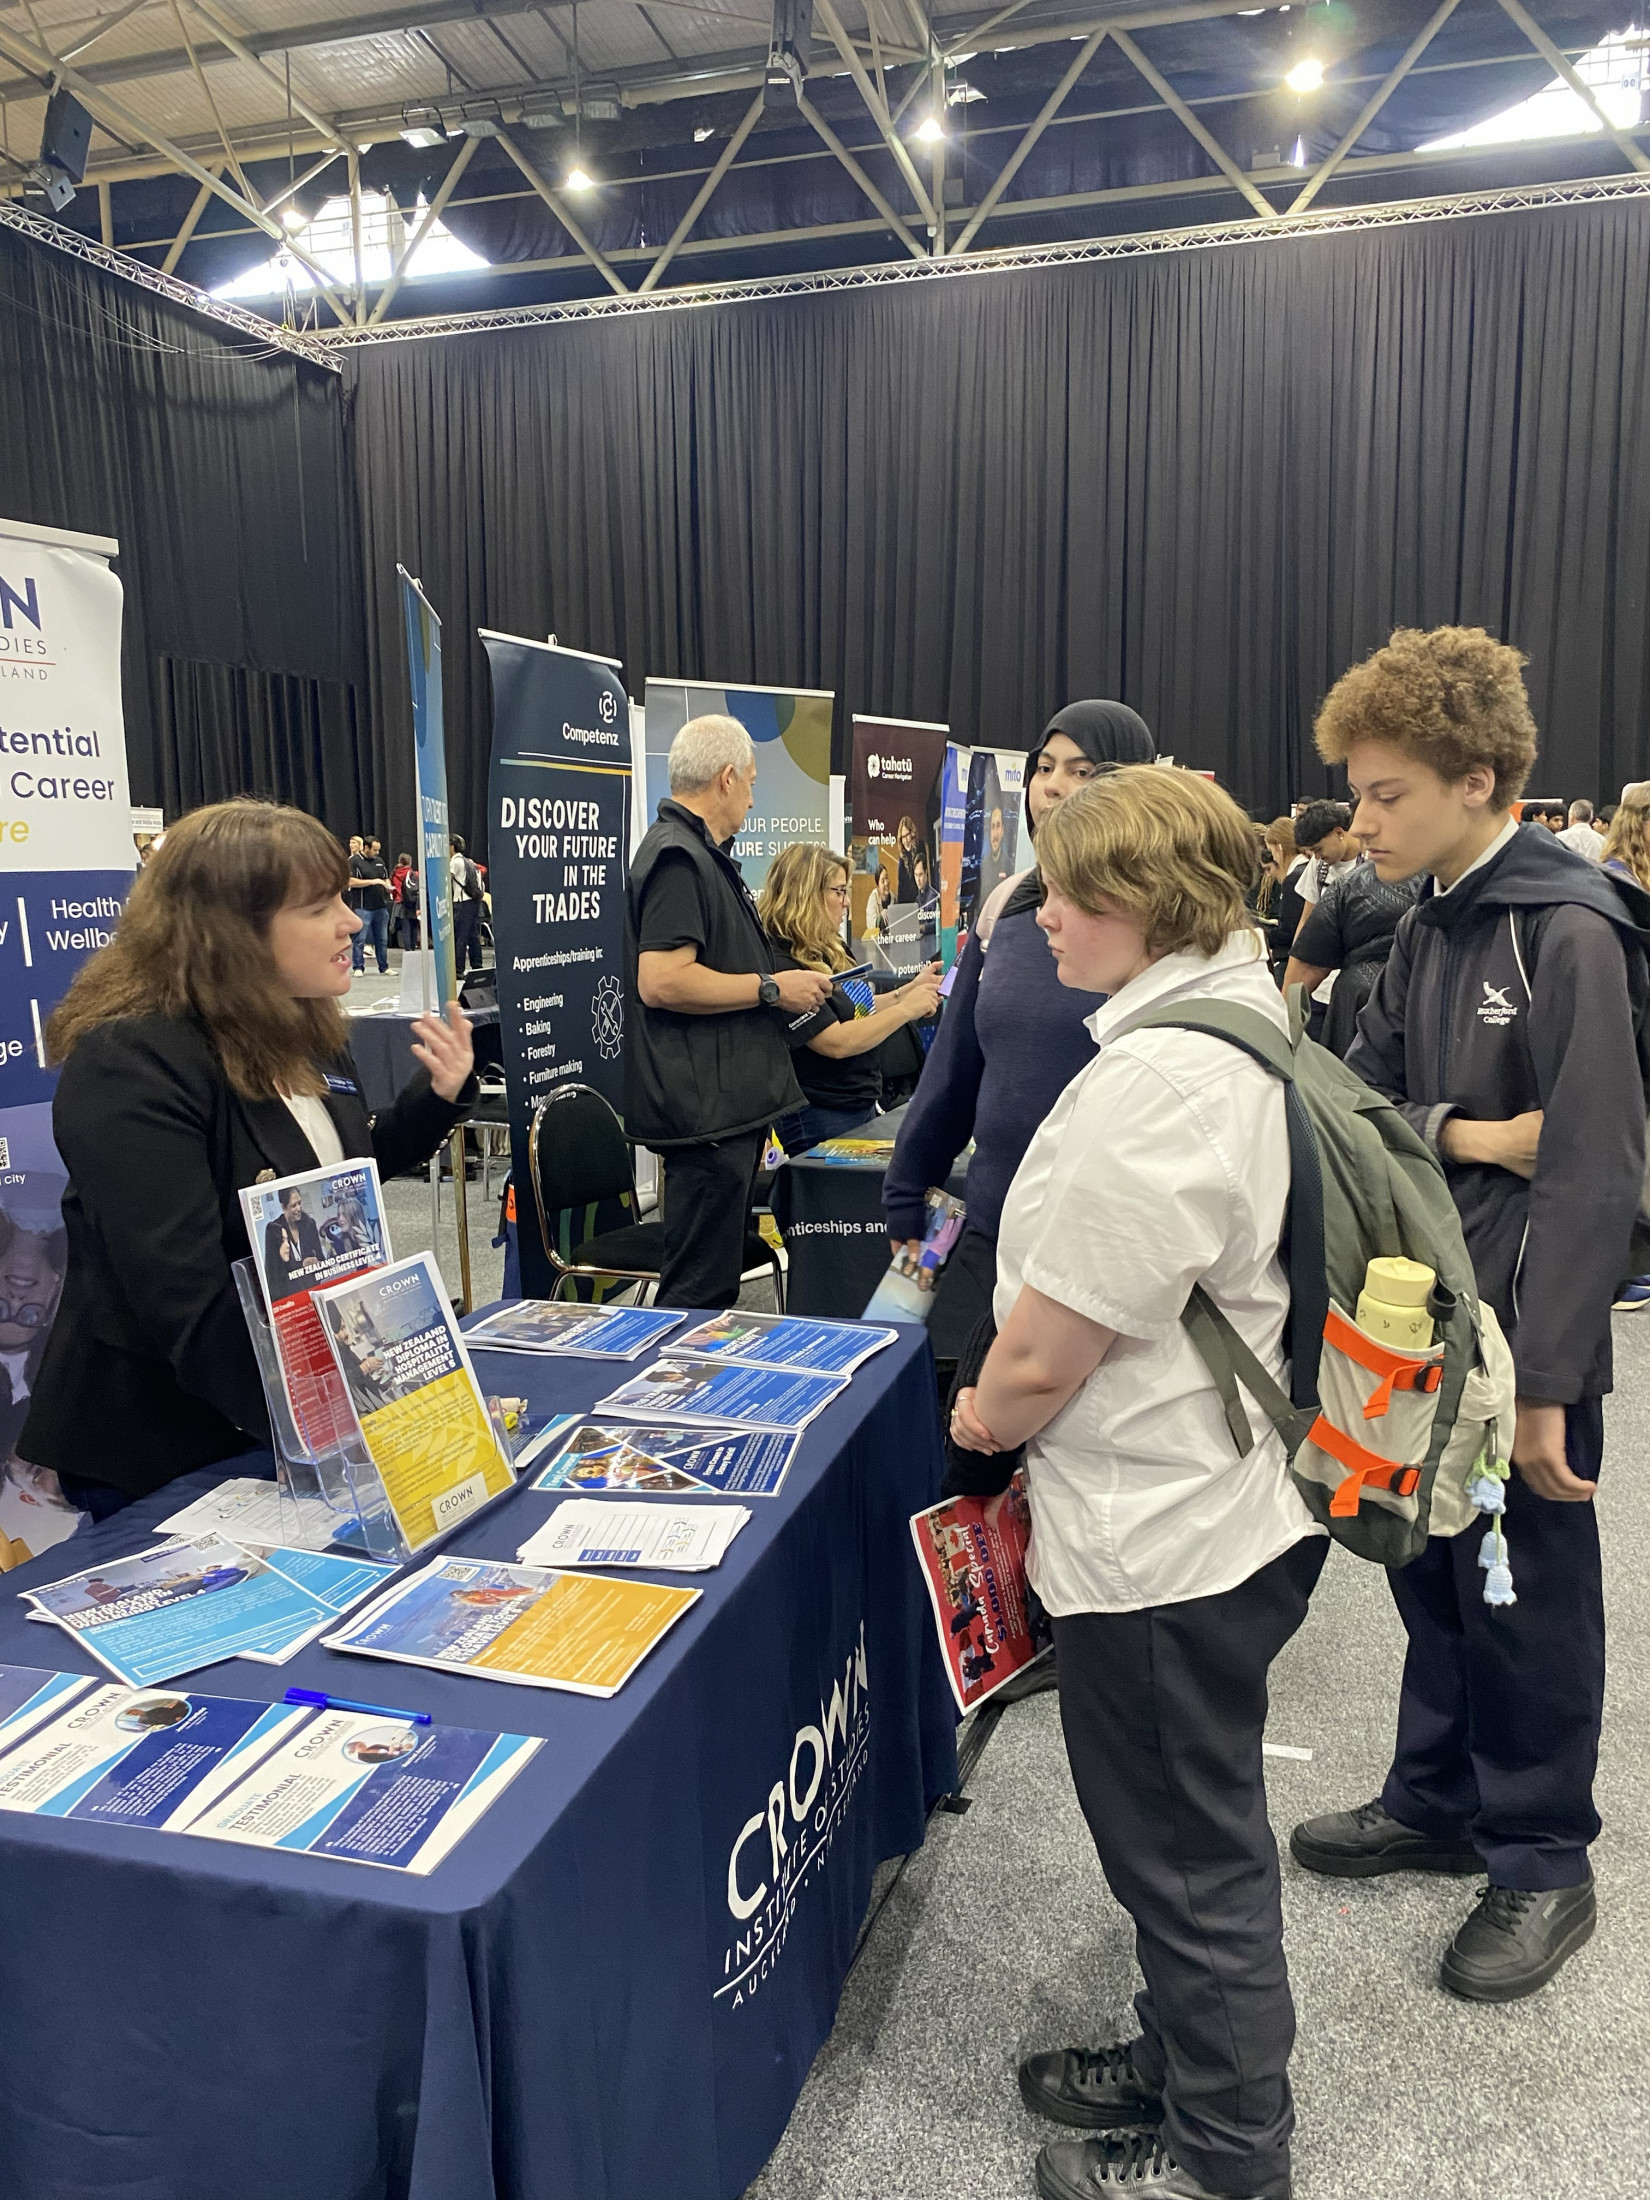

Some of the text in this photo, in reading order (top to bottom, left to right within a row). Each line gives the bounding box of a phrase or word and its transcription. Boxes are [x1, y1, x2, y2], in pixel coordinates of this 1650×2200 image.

[562, 722, 619, 746] Competenz
[881, 755, 912, 772] tahatū
[10, 771, 114, 801] Career
[501, 797, 600, 831] DISCOVER
[771, 817, 824, 833] PEOPLE.
[868, 819, 885, 831] Who
[516, 834, 617, 859] YOUR FUTURE
[868, 833, 897, 847] can help
[563, 865, 606, 887] IN THE
[52, 896, 122, 920] Health
[532, 890, 601, 924] TRADES
[878, 932, 917, 945] their career
[523, 993, 564, 1013] Engineering
[526, 1020, 552, 1036] Baking
[1483, 1016, 1510, 1025] College
[527, 1043, 556, 1061] Forestry
[529, 1059, 583, 1085] Furniture making
[4, 1173, 26, 1185] City
[332, 1173, 366, 1190] CROWN
[288, 1242, 381, 1281] NEW ZEALAND CERTIFICATE
[314, 1271, 325, 1282] IN
[324, 1261, 355, 1279] BUSINESS
[355, 1254, 376, 1269] LEVEL
[379, 1273, 420, 1297] CROWN
[383, 1325, 447, 1361] NEW ZEALAND
[396, 1334, 449, 1364] DIPLOMA IN
[393, 1350, 454, 1386] MANAGEMENT
[394, 1342, 451, 1374] HOSPITALITY
[423, 1360, 457, 1382] LEVEL 5
[683, 1450, 702, 1470] CROWN
[439, 1485, 474, 1514] CROWN
[552, 1523, 576, 1550] CROWN
[95, 1589, 164, 1611] ZEALAND
[156, 1591, 196, 1607] LEVEL
[954, 1522, 1000, 1655] Canada Special
[355, 1623, 392, 1646] CROWN
[453, 1614, 494, 1645] ZEALAND
[462, 1632, 498, 1657] TRAVEL
[491, 1613, 519, 1635] LEVEL
[67, 1692, 122, 1730] CROWN
[294, 1719, 345, 1760] CROWN
[727, 1620, 868, 1919] CROWN
[217, 1791, 265, 1830] GRADUATE
[231, 1772, 303, 1831] TESTIMONIAL
